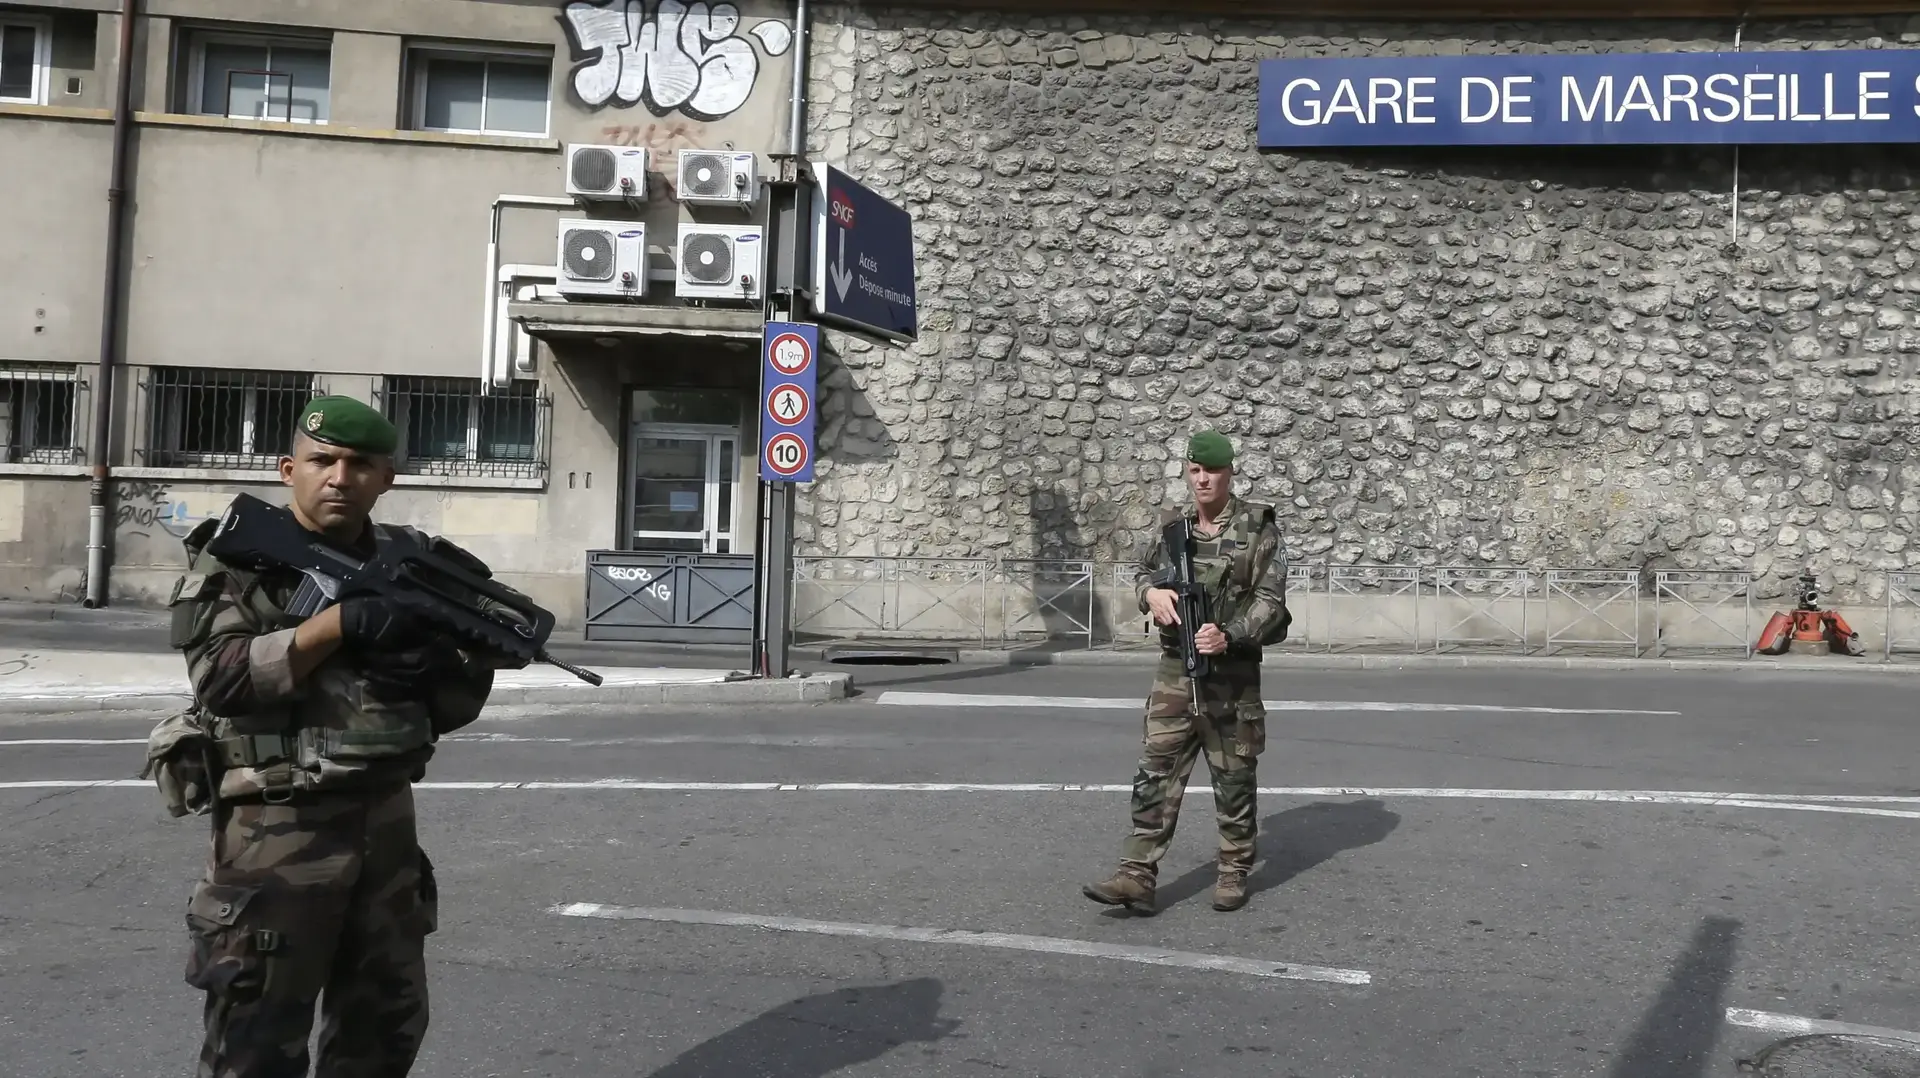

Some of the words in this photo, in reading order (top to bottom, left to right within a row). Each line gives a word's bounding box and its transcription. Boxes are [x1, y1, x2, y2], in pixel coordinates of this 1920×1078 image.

[1280, 77, 1436, 126] GARE
[1460, 76, 1533, 123] DE
[1561, 72, 1891, 122] MARSEILLE
[831, 200, 854, 223] SNCF
[859, 274, 884, 298] Dépose
[884, 286, 911, 307] minute
[775, 444, 799, 463] 10
